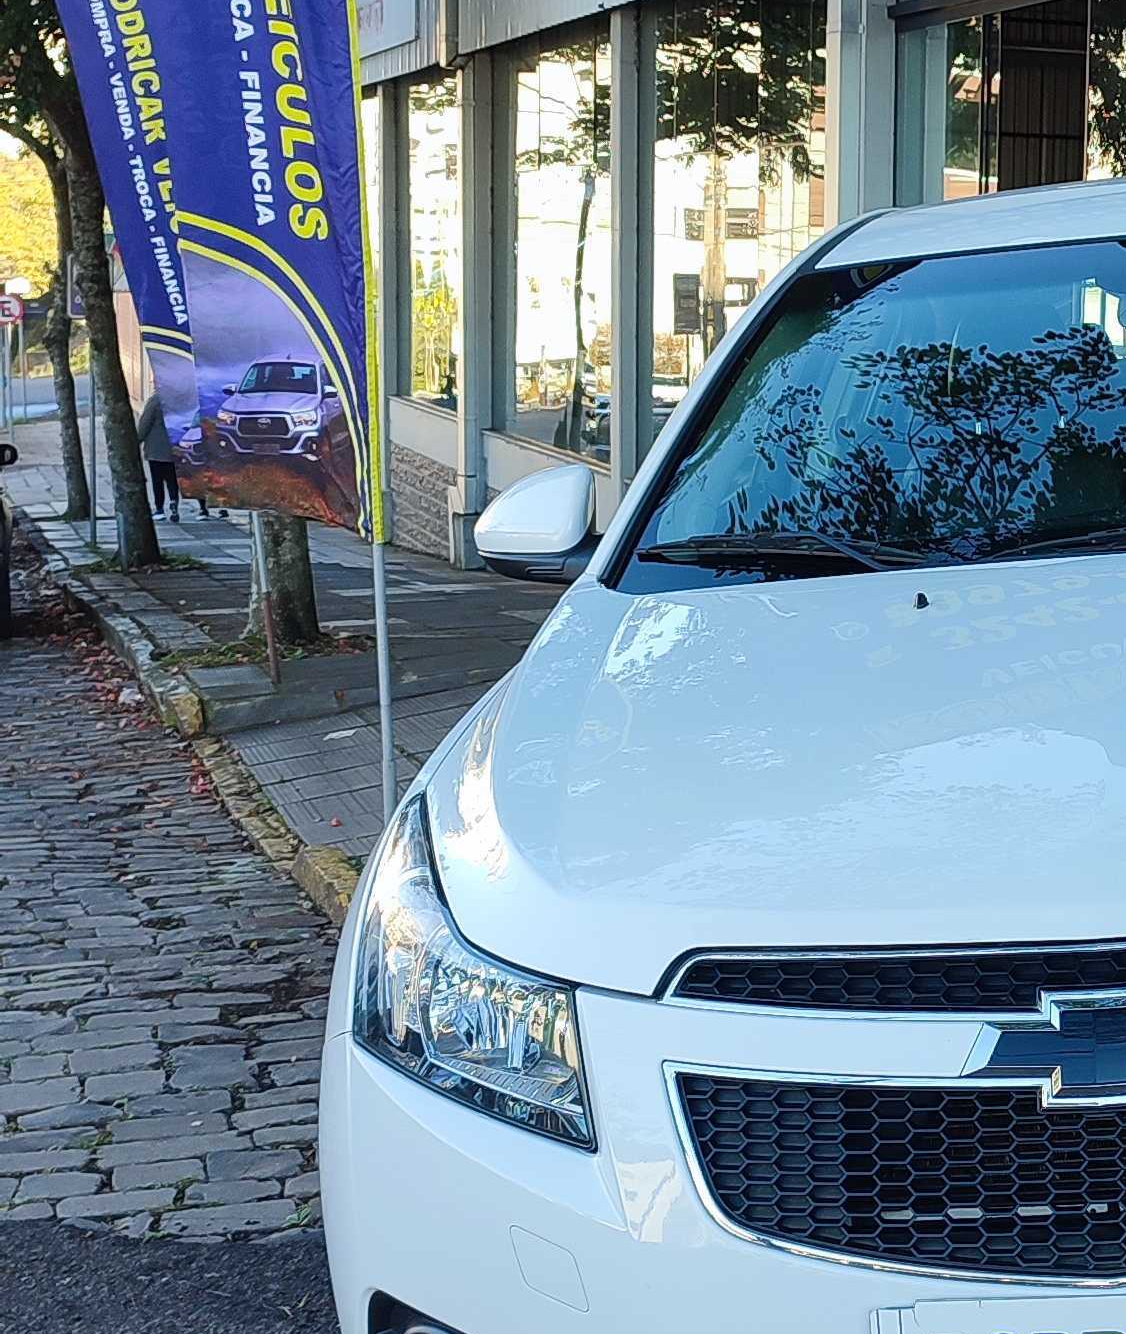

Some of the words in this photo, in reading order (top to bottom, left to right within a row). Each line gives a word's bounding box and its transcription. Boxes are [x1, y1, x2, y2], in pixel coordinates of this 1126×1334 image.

[109, 72, 136, 141] VENDA
[128, 155, 157, 222] TROCA
[151, 235, 188, 336] FINANCIA
[238, 70, 276, 227] FINANCIA
